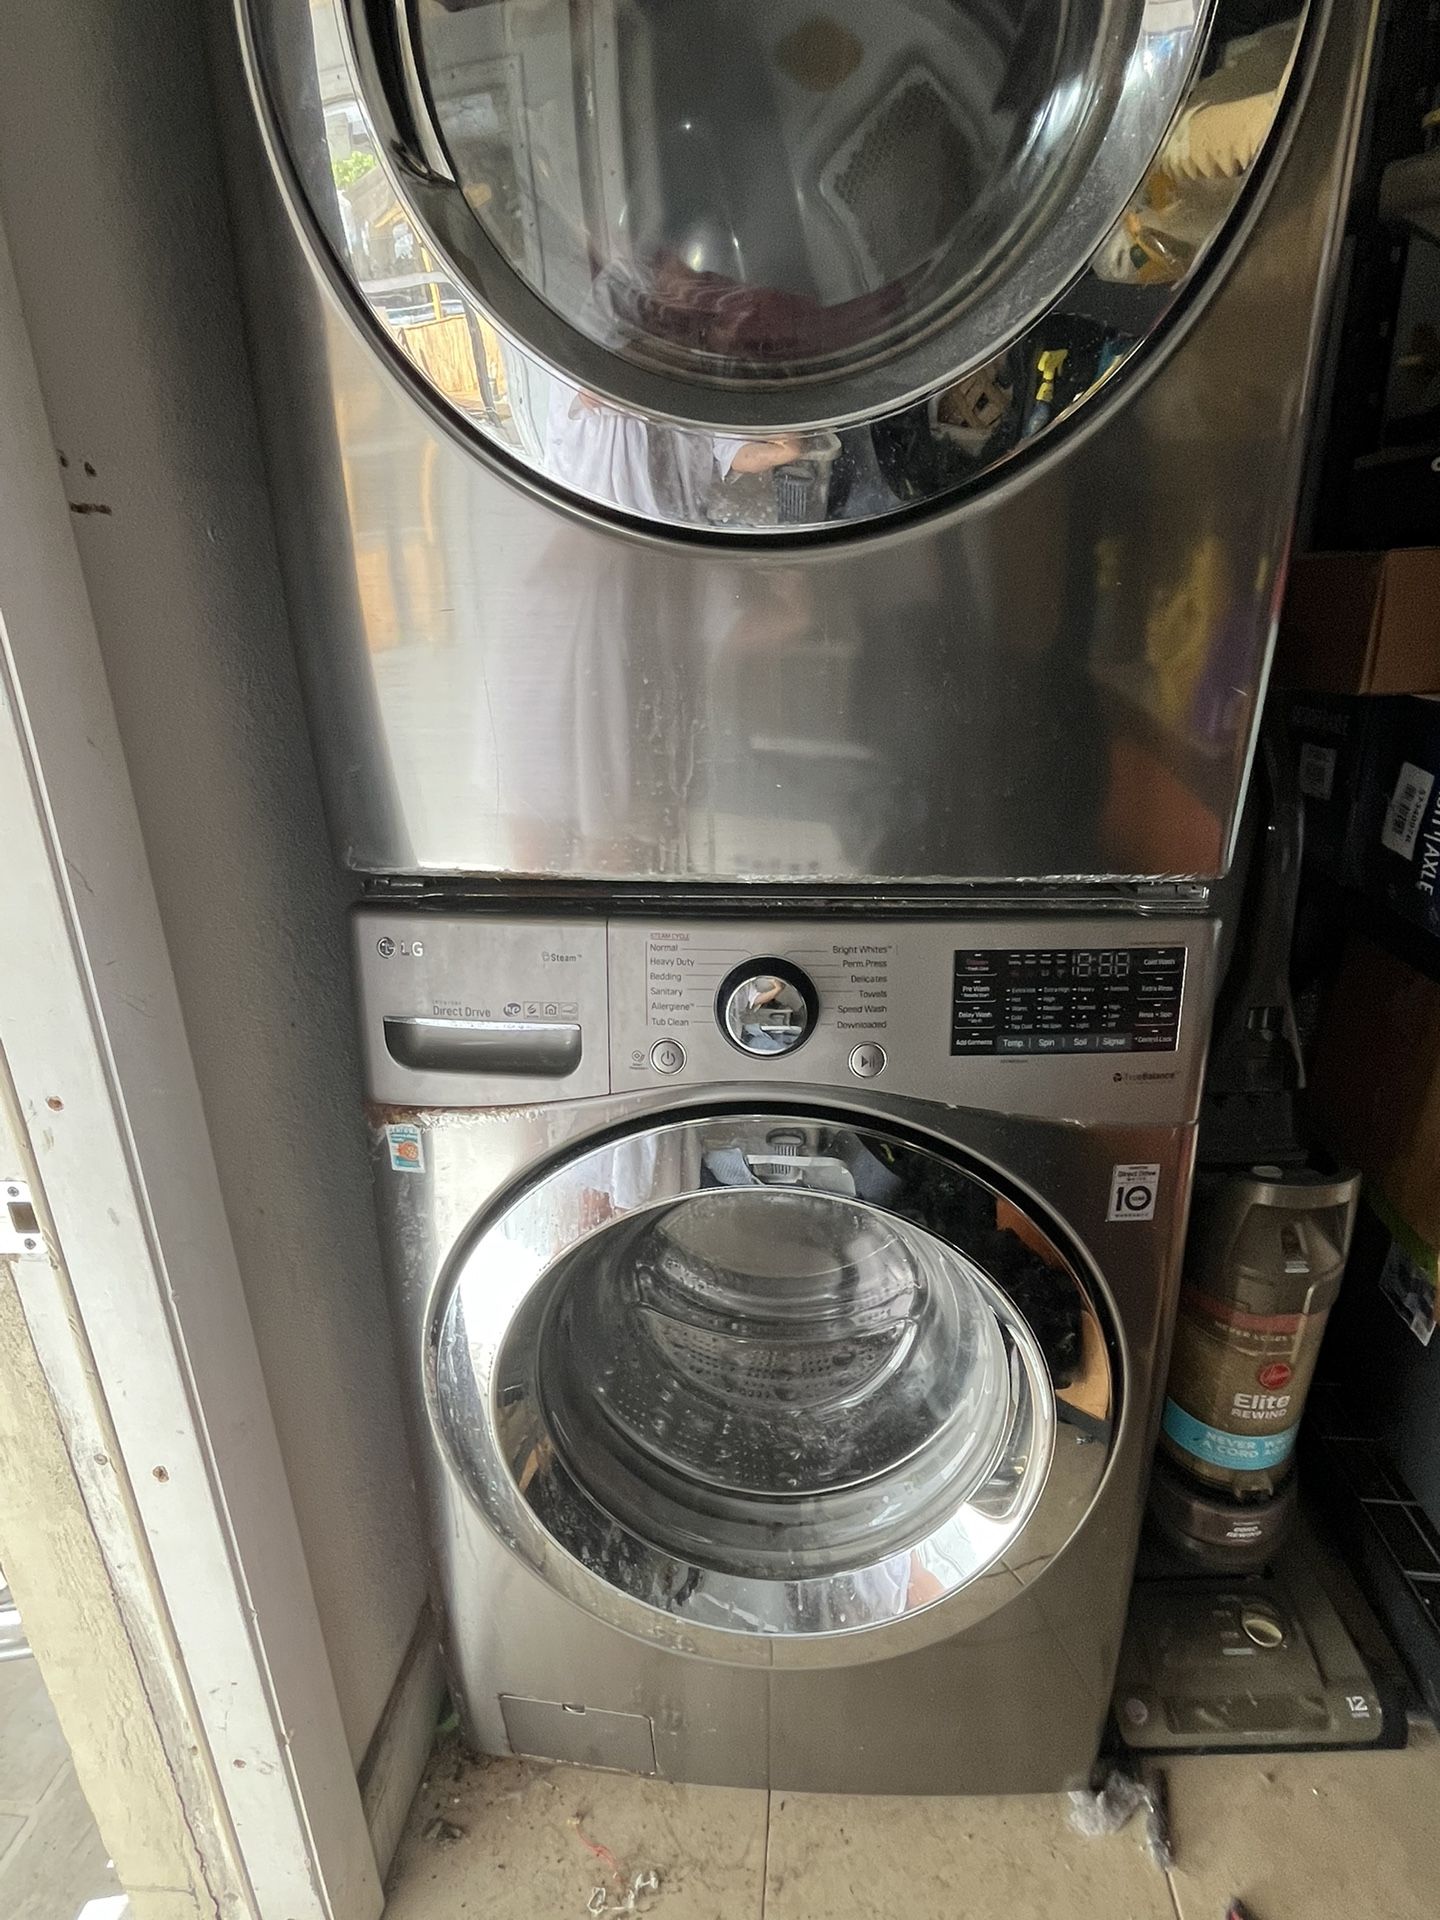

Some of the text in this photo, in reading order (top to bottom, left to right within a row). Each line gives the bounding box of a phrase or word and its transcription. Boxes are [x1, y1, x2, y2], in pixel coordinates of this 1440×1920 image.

[1418, 842, 1440, 896] AXLE
[400, 940, 424, 956] LG
[832, 945, 857, 955] Bright
[650, 958, 695, 967] Heavy Duty
[650, 972, 682, 982] Bedding
[850, 974, 888, 982] Delicates
[650, 986, 683, 996] Sanitary
[859, 990, 888, 998] Towels
[433, 1006, 490, 1018] Direct Drive
[838, 1004, 888, 1014] Speed Wash
[652, 1017, 689, 1026] Tub Clean
[1002, 1038, 1024, 1048] Temp
[1038, 1038, 1056, 1048] Spin
[1073, 1038, 1088, 1046] Soil
[1116, 1186, 1152, 1212] 10
[1234, 1393, 1290, 1410] Elite
[1231, 1408, 1288, 1420] REWIND
[1206, 1431, 1256, 1450] NEVER
[1202, 1440, 1212, 1449] A
[1216, 1446, 1259, 1458] CORD
[1345, 1696, 1368, 1712] 12
